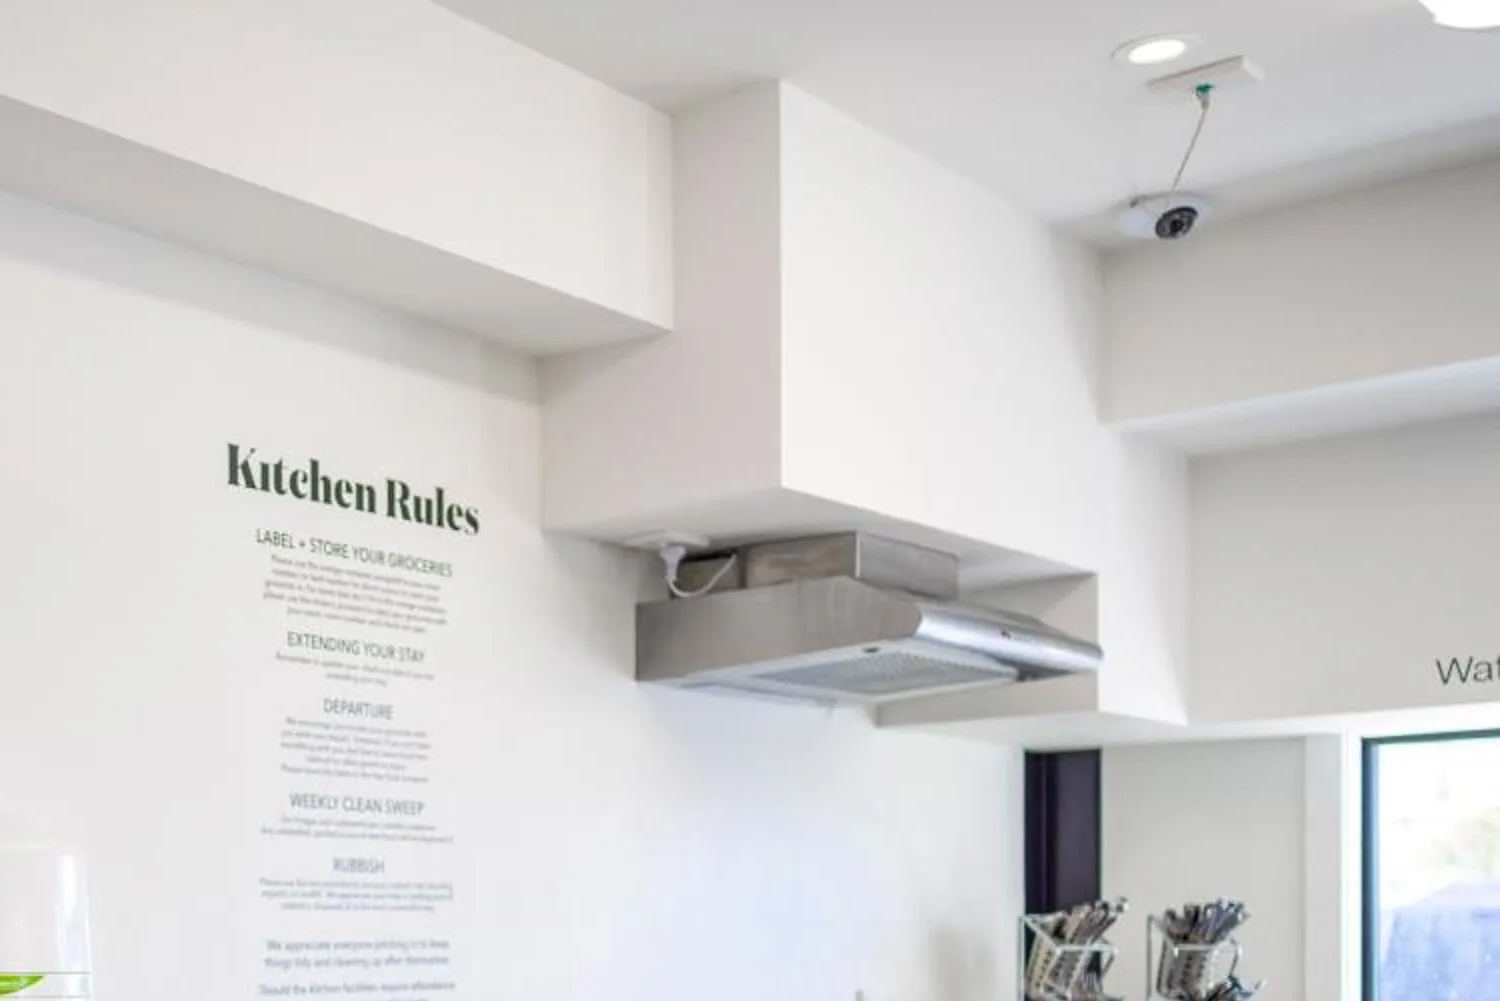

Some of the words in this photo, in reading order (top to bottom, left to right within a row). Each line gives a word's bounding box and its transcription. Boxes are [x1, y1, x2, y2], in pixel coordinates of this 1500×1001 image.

[227, 443, 377, 514] Kitchen
[386, 477, 480, 536] Rules
[256, 528, 297, 549] LABEL
[309, 537, 349, 558] STORE
[352, 546, 385, 566] YOUR
[387, 552, 453, 577] GROCERIES
[287, 631, 360, 656] EXTENDING
[362, 643, 395, 660] YOUR
[398, 647, 426, 663] STAY
[323, 698, 395, 720] DEPARTURE
[289, 792, 339, 811] WEEKLY
[342, 796, 382, 814] CLEAN
[385, 798, 425, 816] SWEEP
[333, 857, 385, 873] RUBBISH
